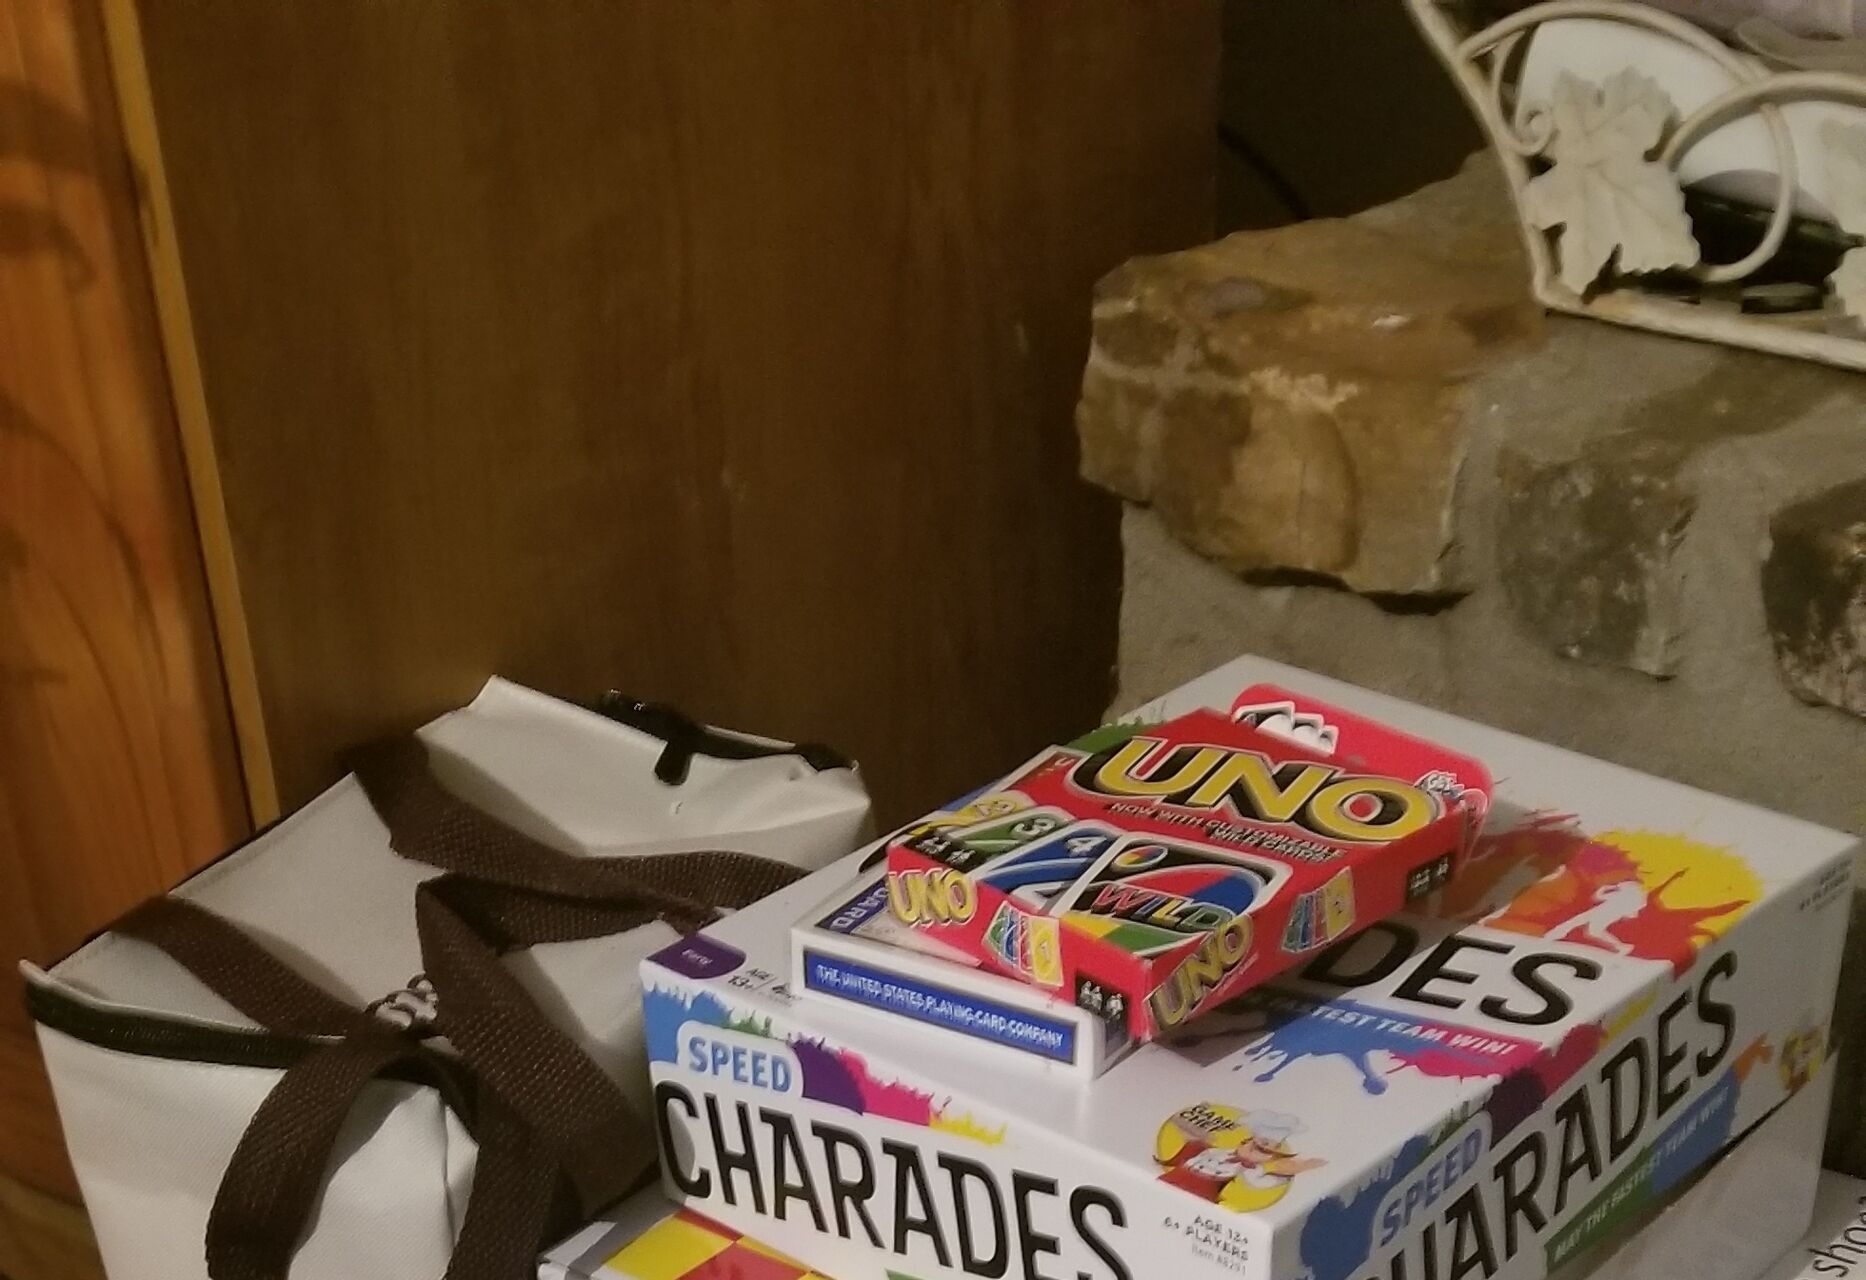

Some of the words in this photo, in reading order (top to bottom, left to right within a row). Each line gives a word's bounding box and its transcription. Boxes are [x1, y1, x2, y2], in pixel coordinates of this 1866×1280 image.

[1092, 734, 1438, 842] UNO
[1111, 801, 1155, 818] NOW
[1157, 809, 1201, 827] WITH
[1067, 836, 1107, 854] 4
[890, 867, 977, 926] UNO
[1090, 883, 1237, 933] WILD
[1148, 914, 1254, 1030] UNO
[816, 964, 841, 982] THE
[842, 970, 882, 995] UNITED
[883, 979, 925, 1006] STATES
[926, 993, 973, 1022] PLAYING
[974, 1009, 1007, 1032] CARD
[1008, 1018, 1063, 1048] COMPANY
[688, 1035, 792, 1094] SPEED
[1376, 1017, 1448, 1042] TEAM
[1450, 1033, 1519, 1055] WIN!
[1379, 1128, 1482, 1248] SPEED
[1185, 1224, 1249, 1262] PLAYERS
[1194, 1214, 1222, 1234] AGE
[1806, 1195, 1866, 1278] sho
